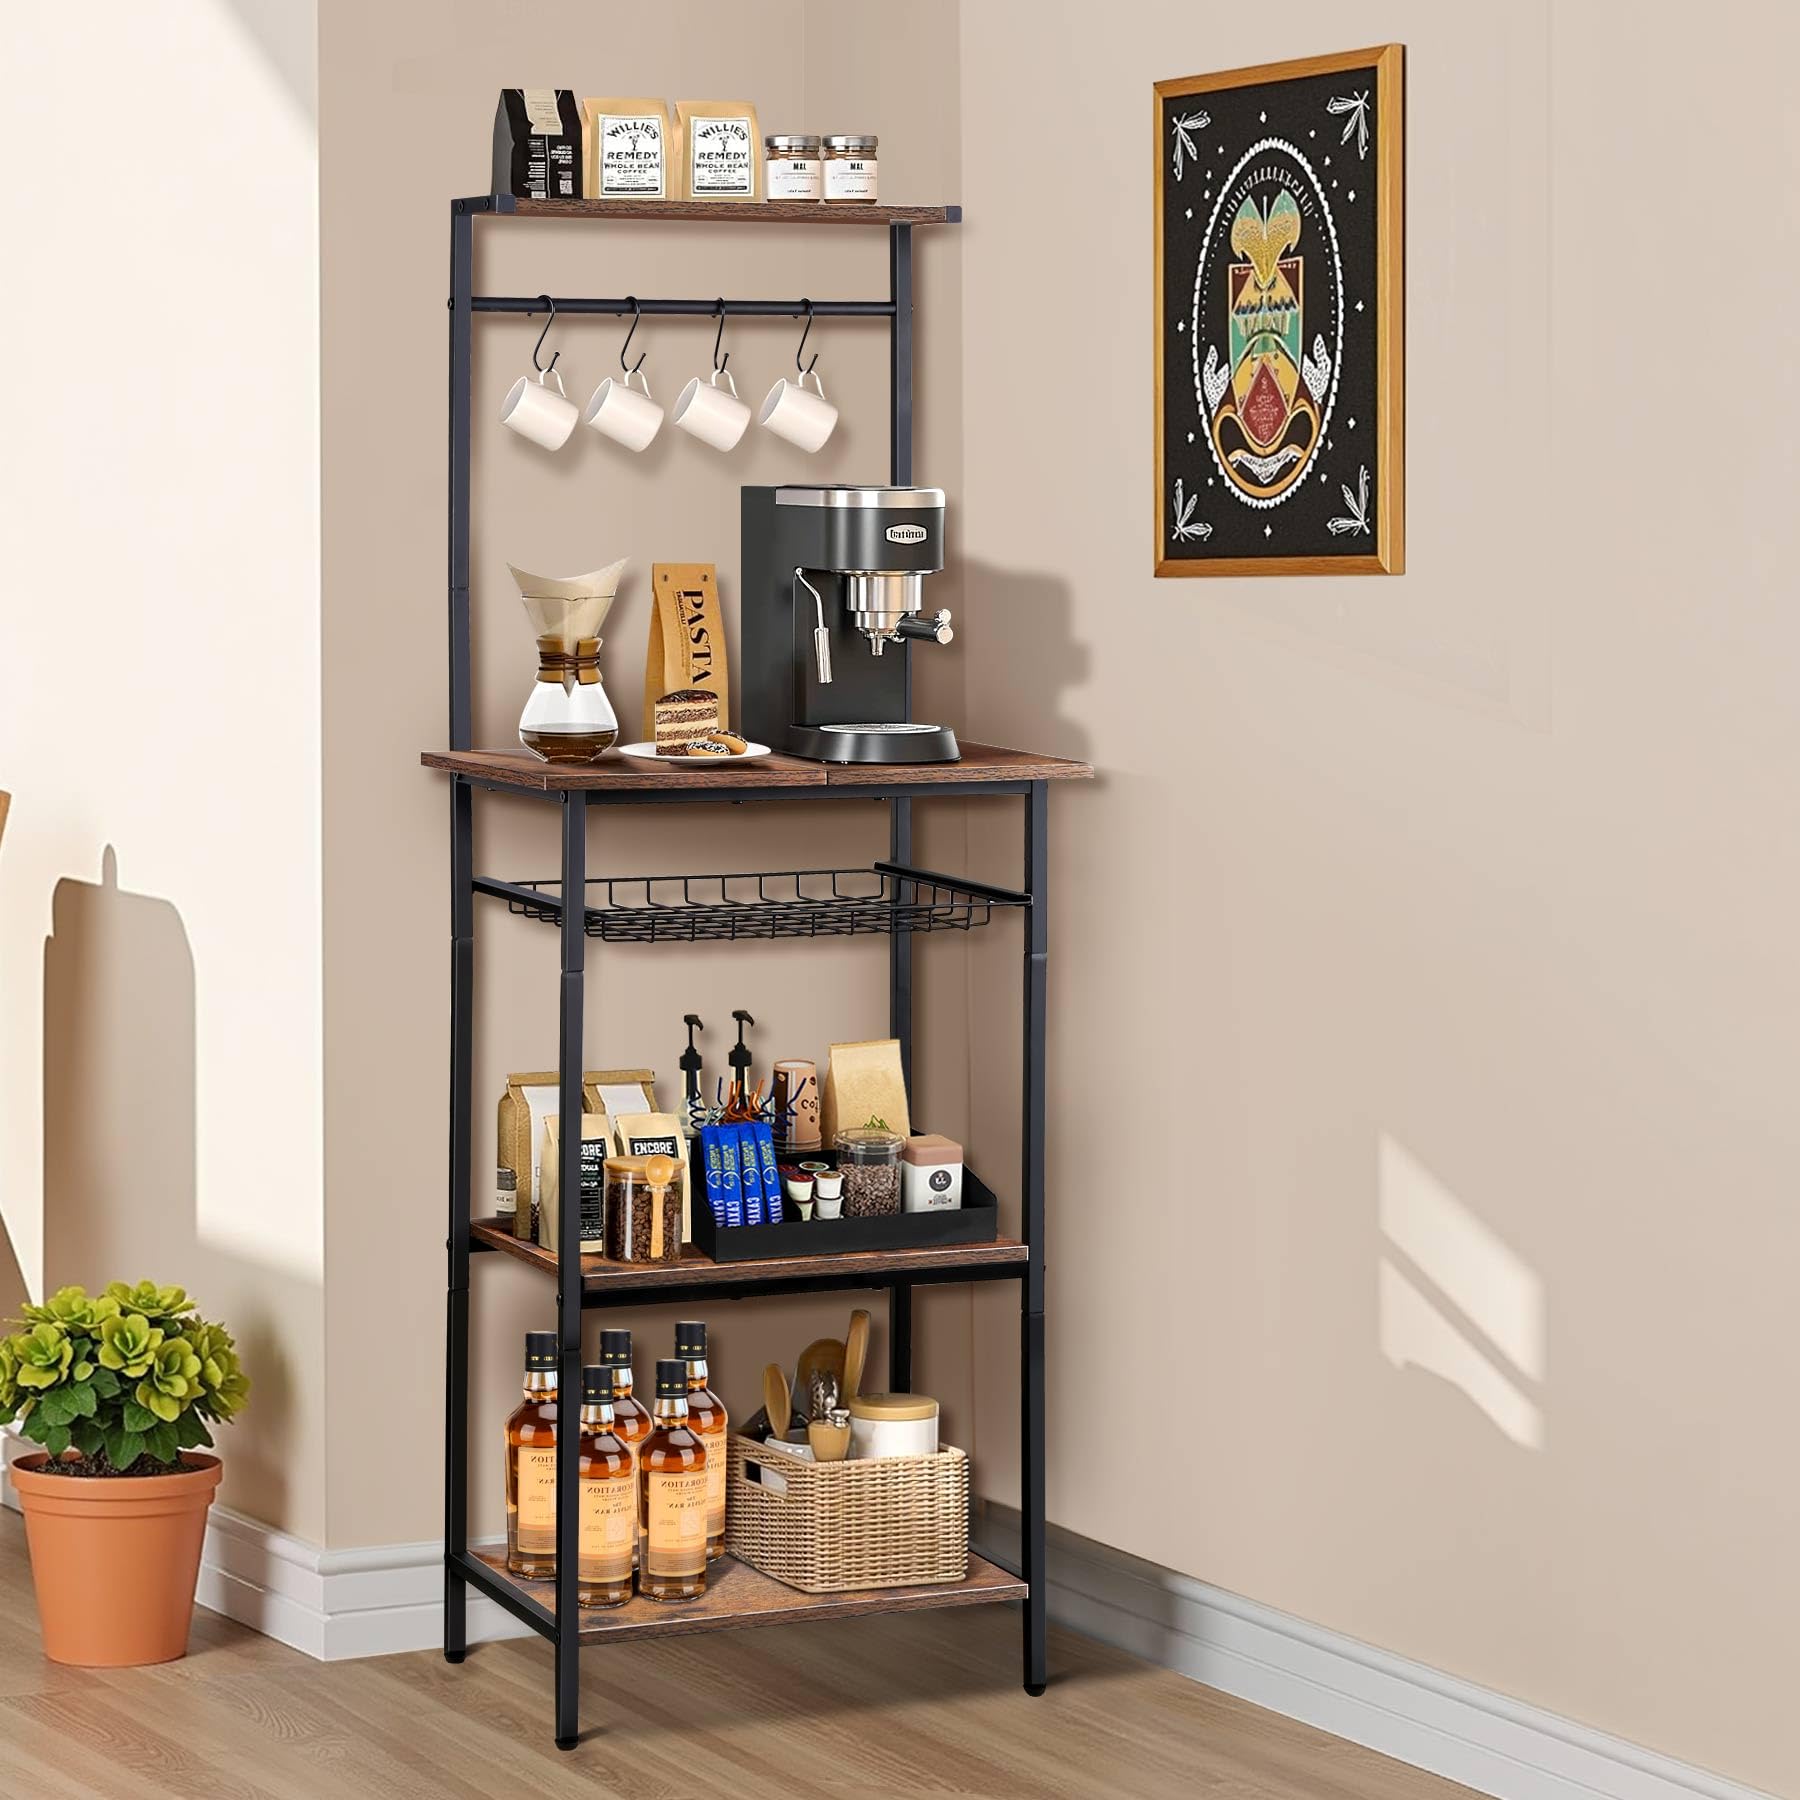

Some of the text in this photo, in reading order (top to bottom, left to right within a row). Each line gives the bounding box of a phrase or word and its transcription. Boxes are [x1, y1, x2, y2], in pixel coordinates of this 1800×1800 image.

[606, 121, 659, 140] WILLIE'S
[698, 123, 748, 141] WILLIE'S
[607, 151, 659, 160] REMEDY
[698, 151, 747, 160] REMEDY
[682, 590, 712, 684] PASTA
[633, 1141, 674, 1155] ENCORE
